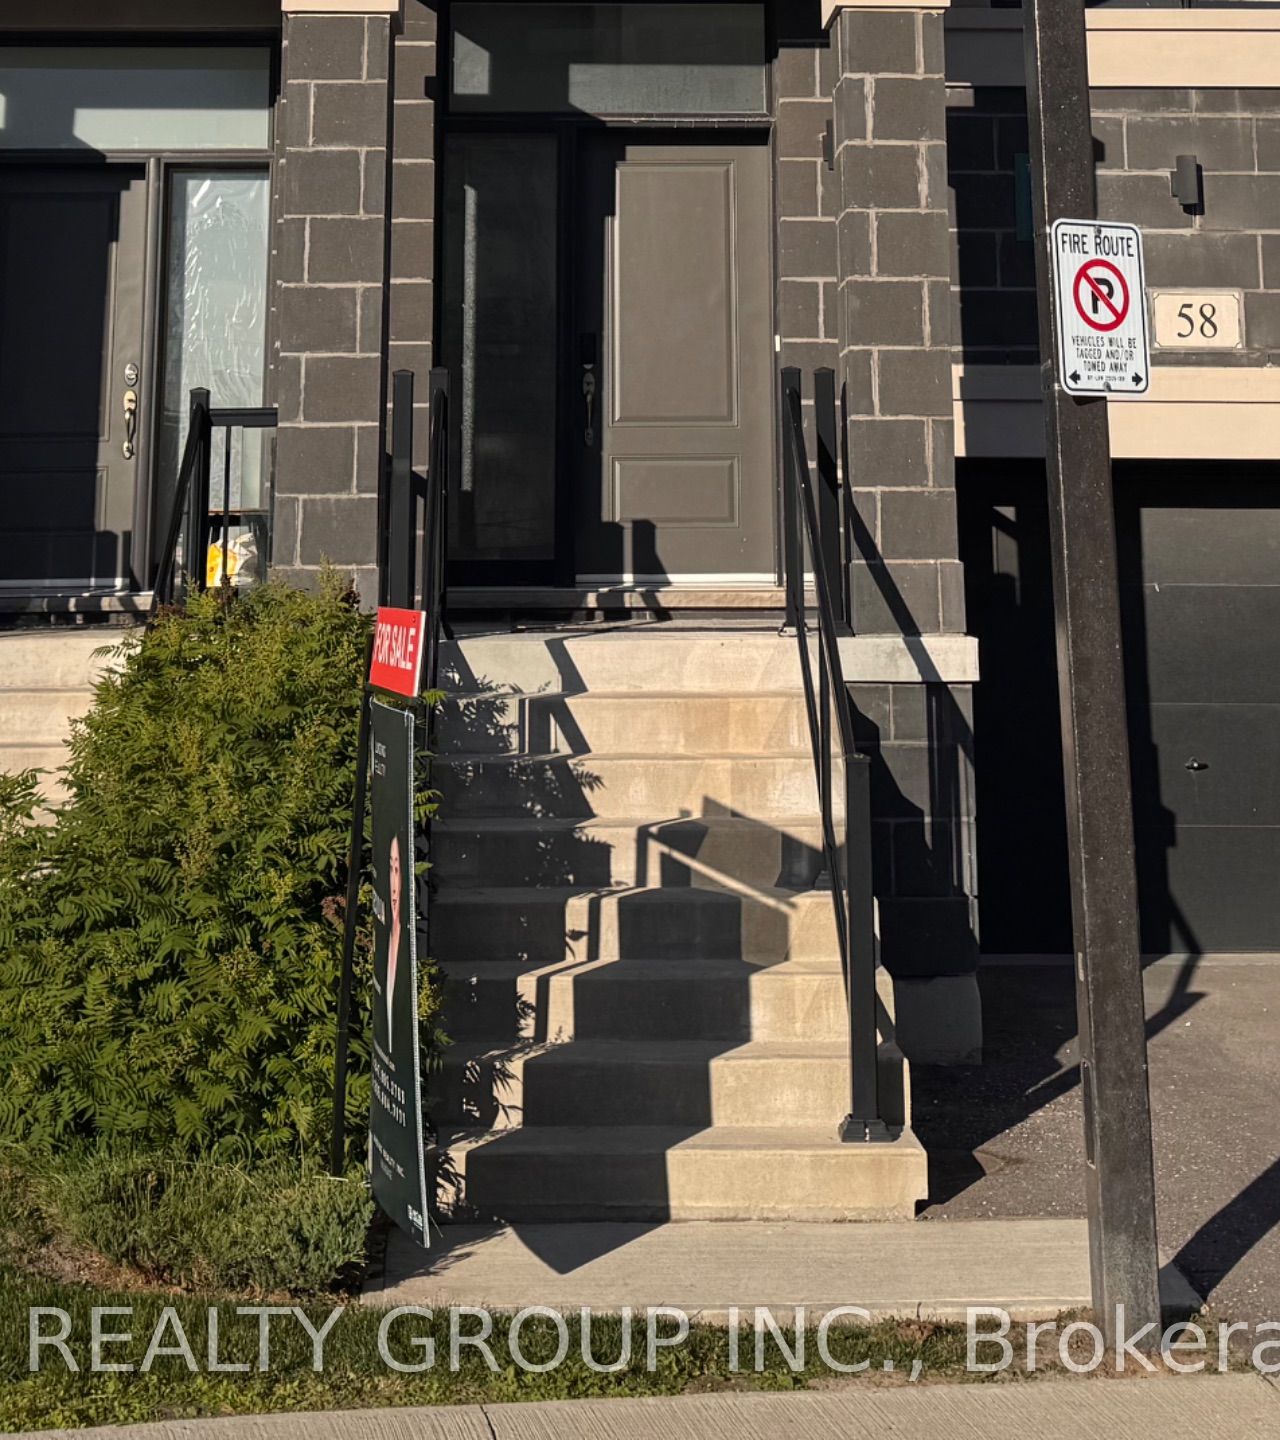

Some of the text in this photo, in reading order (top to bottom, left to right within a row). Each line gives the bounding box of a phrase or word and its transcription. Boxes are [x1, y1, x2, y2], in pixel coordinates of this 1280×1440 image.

[1061, 233, 1134, 258] FIRE ROUTE
[1177, 303, 1218, 338] 58
[1071, 335, 1137, 349] VEHICLES WILL BE
[1076, 347, 1134, 361] TAGGED AND/OR
[1083, 360, 1128, 373] TOWED AWAY
[390, 624, 416, 670] SALE
